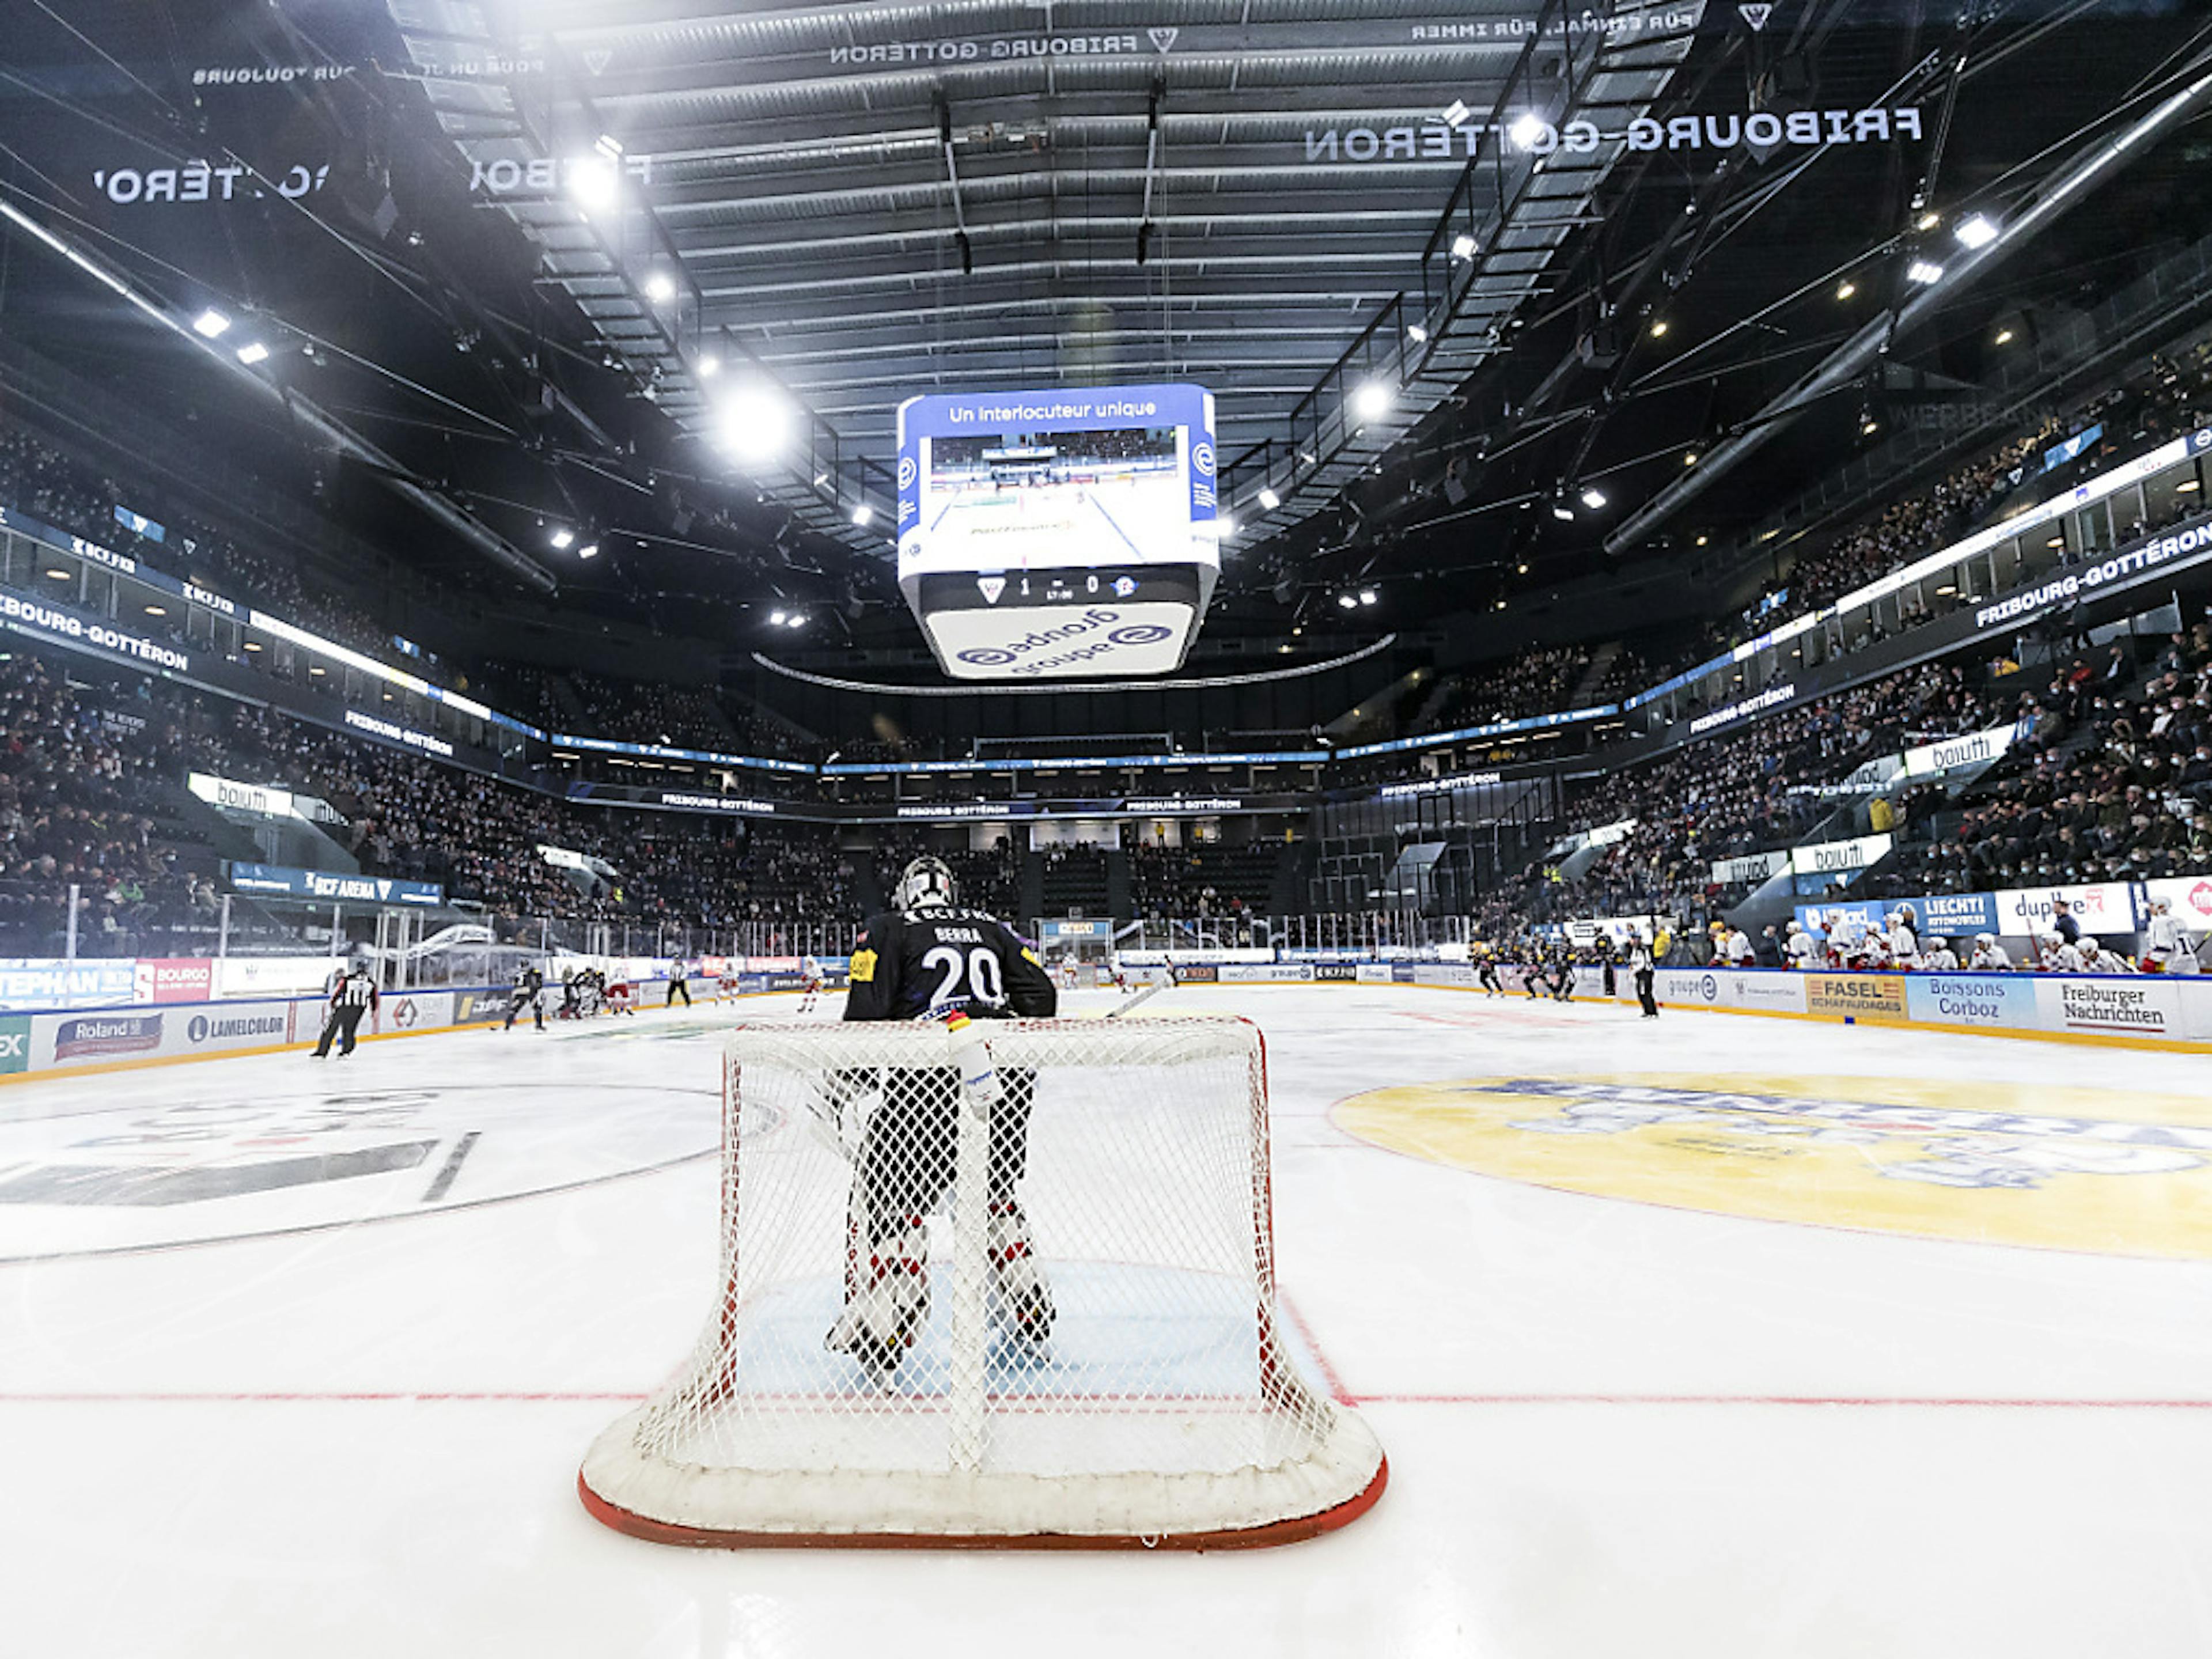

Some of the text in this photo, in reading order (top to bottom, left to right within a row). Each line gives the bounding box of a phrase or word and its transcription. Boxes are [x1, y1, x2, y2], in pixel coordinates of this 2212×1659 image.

[949, 400, 1157, 422] Un interlocuteur unique
[1021, 576, 1099, 595] 1 0
[1925, 896, 1984, 914] LIECHTI
[934, 927, 984, 943] BERRA
[157, 968, 209, 982] BOURGO
[922, 946, 1006, 1006] 20
[1825, 980, 1884, 998] FASEL
[1930, 978, 2005, 998] Boissons
[2061, 984, 2146, 1008] Freiburger
[1940, 998, 1999, 1018] Corboz
[2065, 1003, 2165, 1024] Nachrichten
[75, 1021, 128, 1039] Roland
